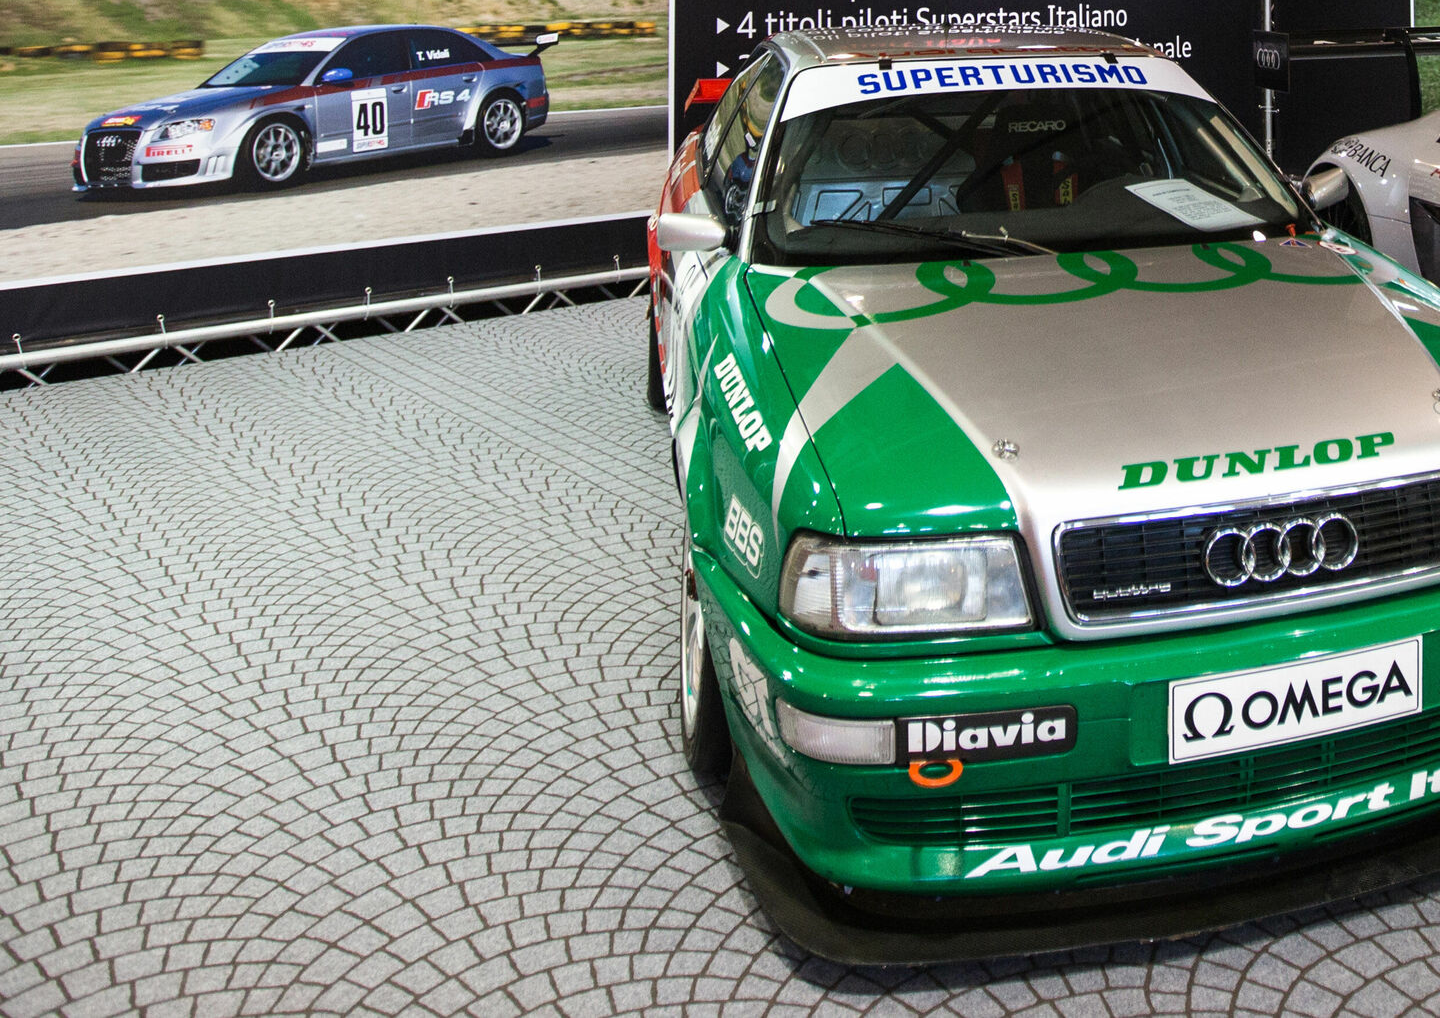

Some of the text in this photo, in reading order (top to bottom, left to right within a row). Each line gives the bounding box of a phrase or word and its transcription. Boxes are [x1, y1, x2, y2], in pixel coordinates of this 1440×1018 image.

[736, 11, 757, 39] 4
[764, 8, 833, 36] titoli
[916, 7, 1042, 29] Superstars
[1047, 3, 1128, 28] Italiano
[456, 88, 471, 102] 4
[857, 63, 1148, 95] SUPERTURISMO
[356, 101, 385, 137] 40
[1008, 119, 1066, 133] RECARO
[145, 144, 193, 158] PIRELLI
[1348, 140, 1392, 178] BANCA
[714, 352, 774, 453] DUNLOP
[1117, 431, 1396, 491] DUNLOP
[723, 495, 767, 567] BBS
[1241, 660, 1414, 725] OMEGA
[907, 711, 1067, 754] Diavia
[964, 825, 1171, 880] Audi
[1185, 781, 1398, 848] Sport
